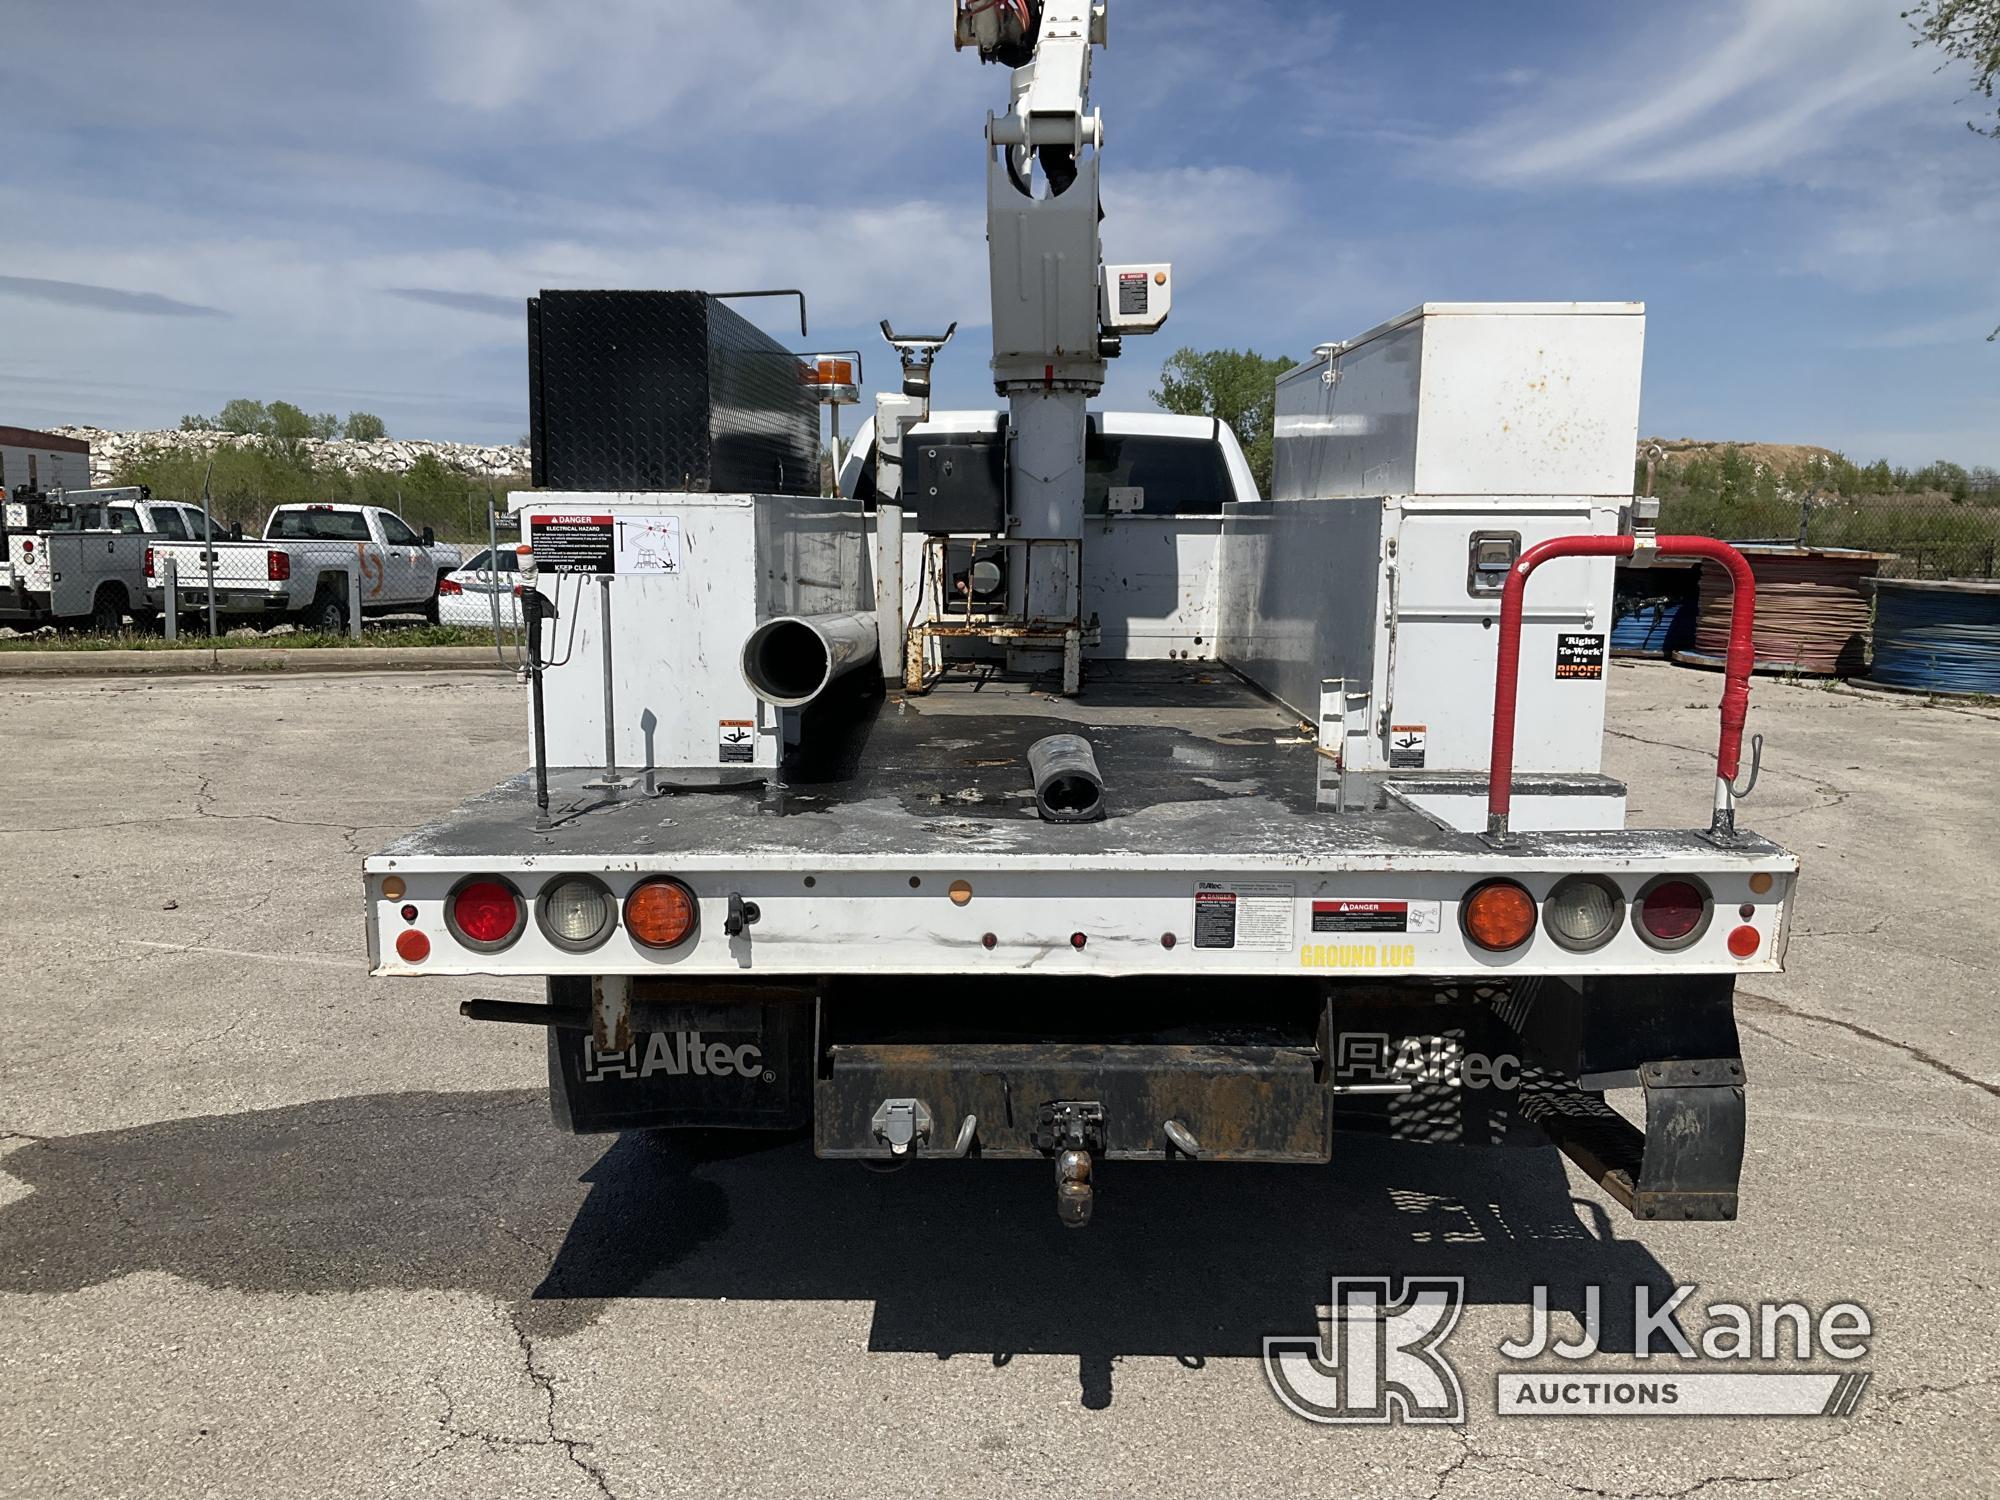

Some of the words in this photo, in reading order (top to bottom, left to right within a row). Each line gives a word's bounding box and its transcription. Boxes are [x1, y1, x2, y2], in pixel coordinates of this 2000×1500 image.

[559, 516, 592, 524] DANGER
[1557, 665, 1602, 676] RIPOFF
[1300, 944, 1376, 967] GROUND
[1381, 944, 1415, 967] LUG
[1390, 1036, 1521, 1090] Altec
